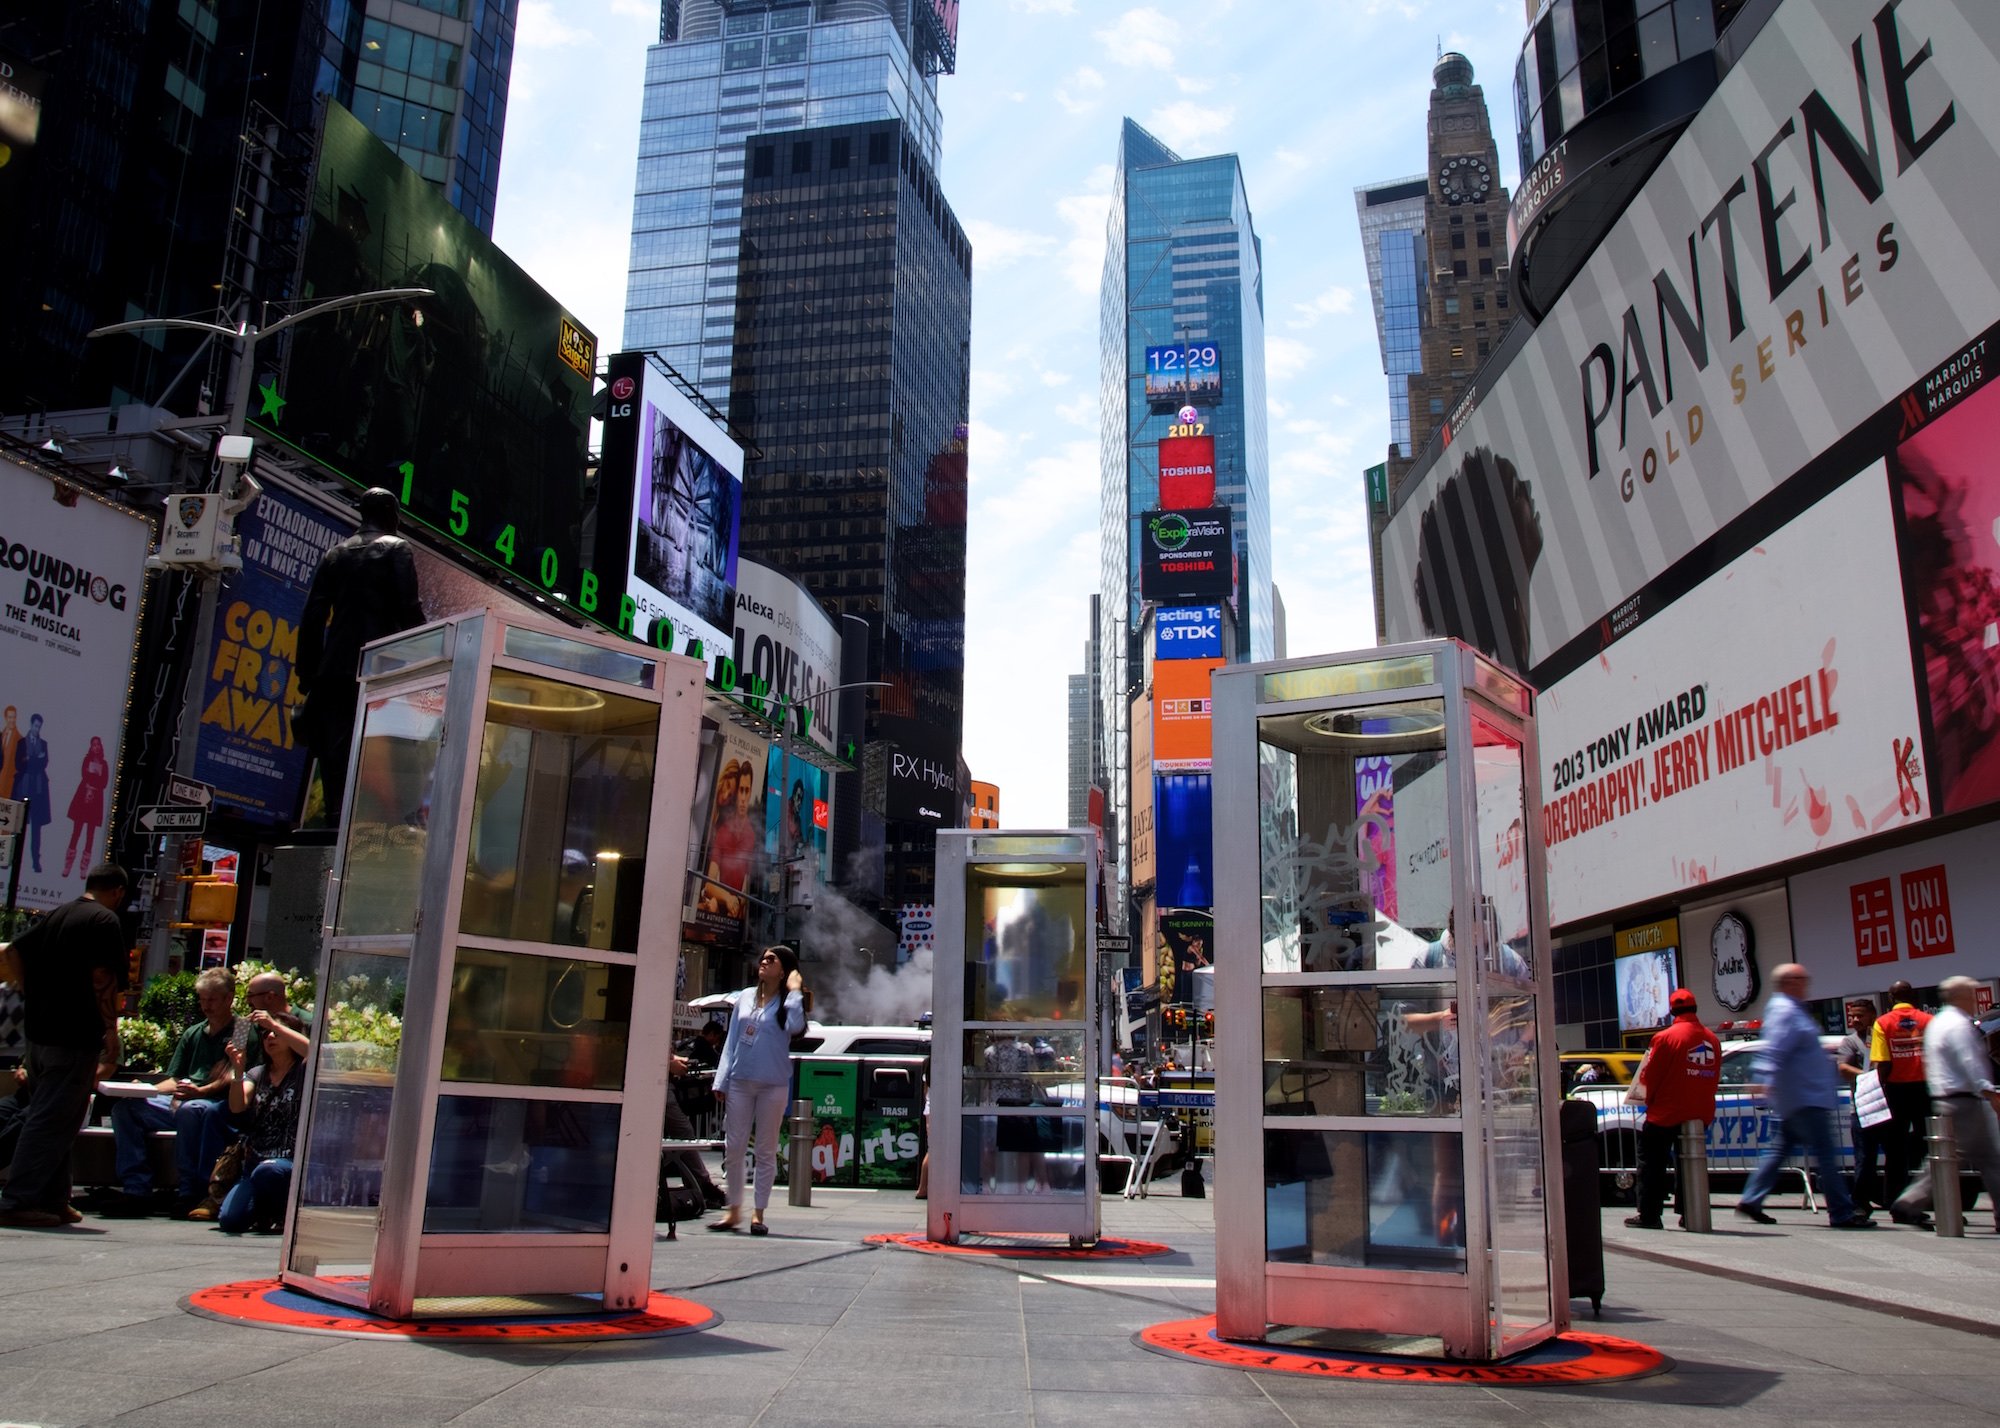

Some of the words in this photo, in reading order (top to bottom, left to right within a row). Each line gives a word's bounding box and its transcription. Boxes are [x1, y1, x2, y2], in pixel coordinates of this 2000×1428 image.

[1515, 139, 1568, 210] MARRIOTT
[1517, 168, 1562, 230] MARQUIS
[1580, 0, 1957, 481] PANTENE
[562, 338, 589, 375] Saigon
[1150, 347, 1216, 371] 12:29
[1620, 404, 1704, 502] GOLD
[1729, 222, 1899, 405] SERIES
[1926, 340, 1986, 394] MARRIOTT
[1929, 365, 1982, 412] MARQUIS
[611, 404, 631, 418] LG
[1168, 424, 1204, 438] 2017
[1161, 465, 1213, 477] TOSHIBA
[1149, 518, 1160, 530] 25
[1159, 526, 1225, 540] ExploraVision
[263, 523, 319, 567] TRANSPORTS
[1160, 551, 1202, 560] SPONSORED
[247, 539, 262, 561] ON
[261, 547, 270, 565] A
[271, 549, 299, 579] WAVE
[299, 563, 312, 584] OF
[1161, 561, 1215, 572] TOSHIBA
[24, 578, 72, 618] DAY
[636, 594, 647, 613] LG
[1612, 595, 1641, 623] MARRIOTT
[6, 603, 27, 622] THE
[31, 613, 81, 641] MUSICAL
[225, 601, 299, 664] COM
[1173, 625, 1217, 640] TDK
[1613, 611, 1639, 636] MARQUIS
[1650, 724, 1710, 803] JERRY
[1714, 667, 1839, 776] MITCHELL
[893, 753, 919, 780] RX
[923, 760, 954, 791] Hybrid
[1553, 751, 1585, 792] 2013
[1586, 723, 1632, 774] TONY
[174, 783, 188, 798] ONE
[189, 788, 202, 800] WAY
[156, 814, 176, 825] ONE
[179, 814, 199, 825] WAY
[1906, 878, 1941, 911] UNI
[1182, 920, 1204, 928] SKINNY
[1911, 914, 1948, 952] QLO
[817, 1106, 842, 1114] PAPER
[882, 1107, 908, 1116] TRASH
[1174, 1094, 1198, 1104] POLICE
